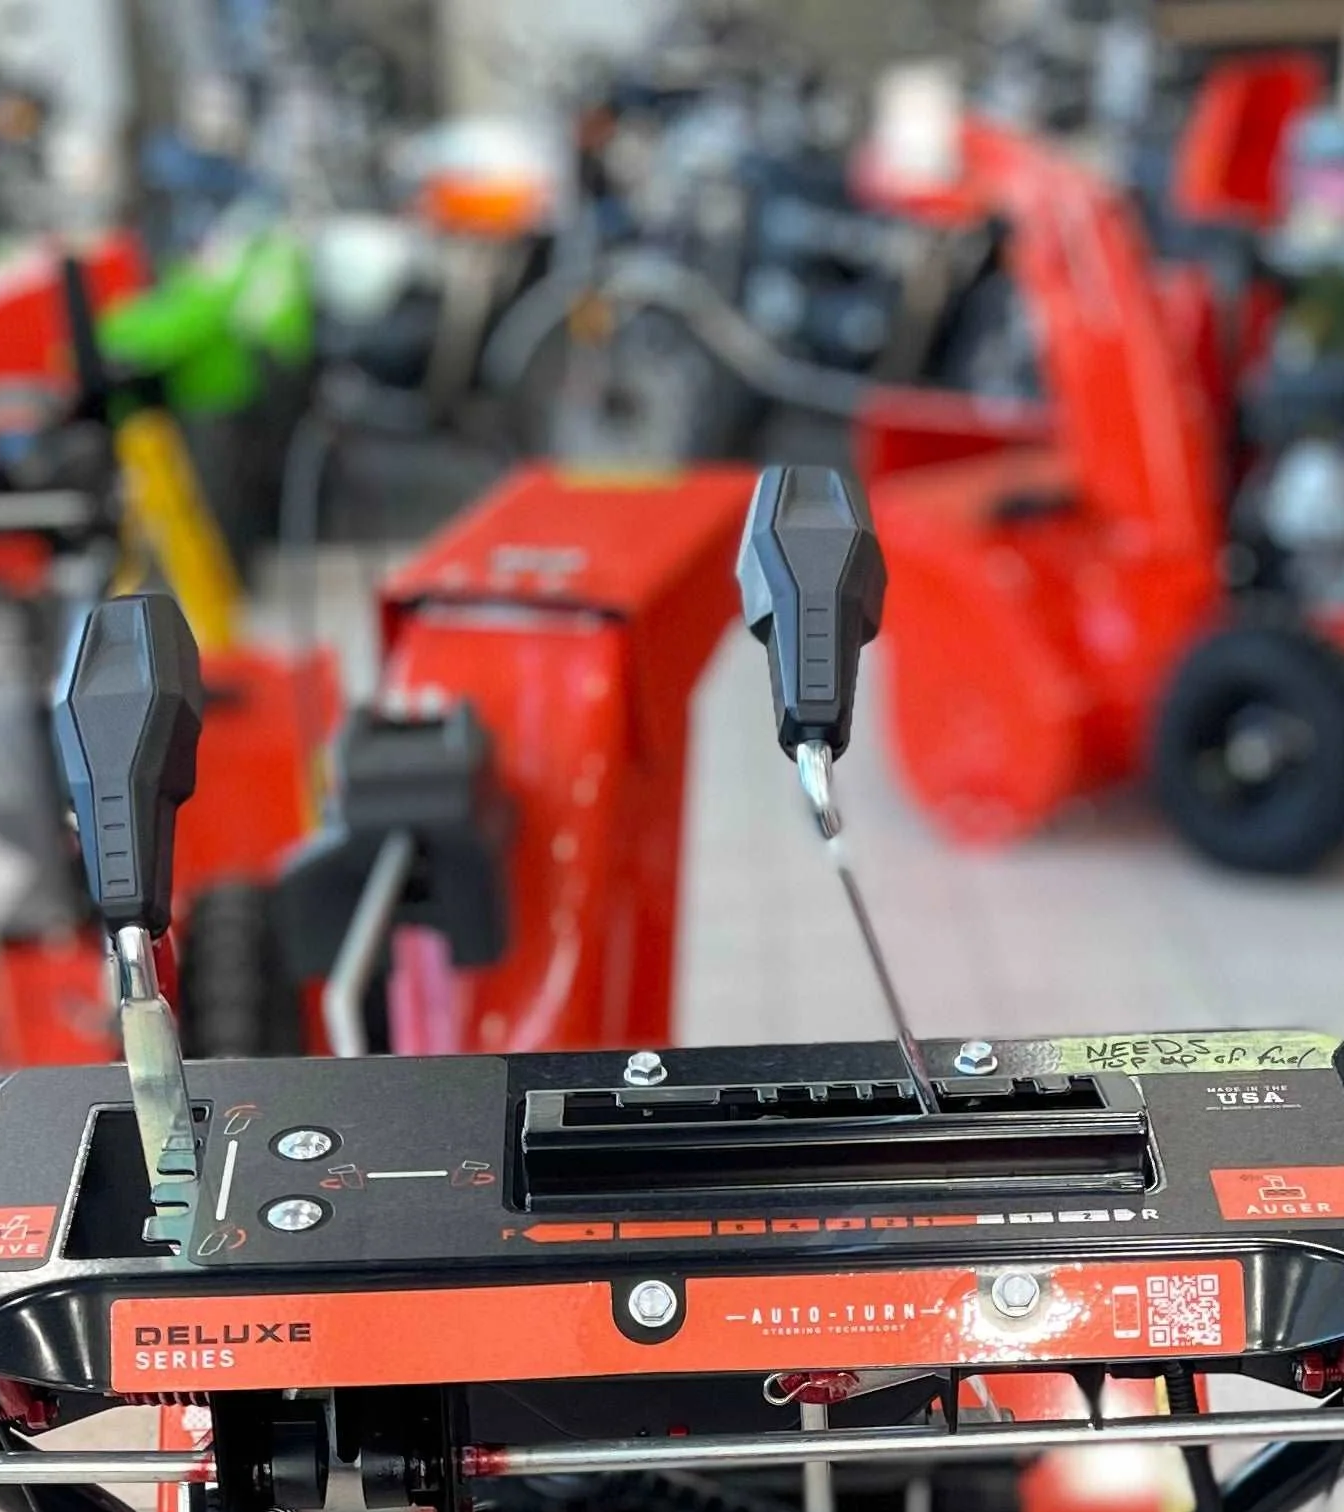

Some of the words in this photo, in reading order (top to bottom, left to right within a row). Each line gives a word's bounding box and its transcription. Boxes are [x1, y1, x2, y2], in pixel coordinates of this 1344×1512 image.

[1086, 1038, 1211, 1059] NEEDS
[1216, 1091, 1285, 1105] USA
[1247, 1202, 1332, 1215] AUGER
[502, 1228, 515, 1241] F
[1083, 1212, 1092, 1221] 2
[1141, 1208, 1159, 1220] R
[751, 1303, 916, 1325] AUTO-TURN
[135, 1322, 312, 1346] DELUXE
[762, 1326, 822, 1336] STEERING
[828, 1323, 906, 1334] TECHNOLOGY
[135, 1349, 236, 1371] SERIES
